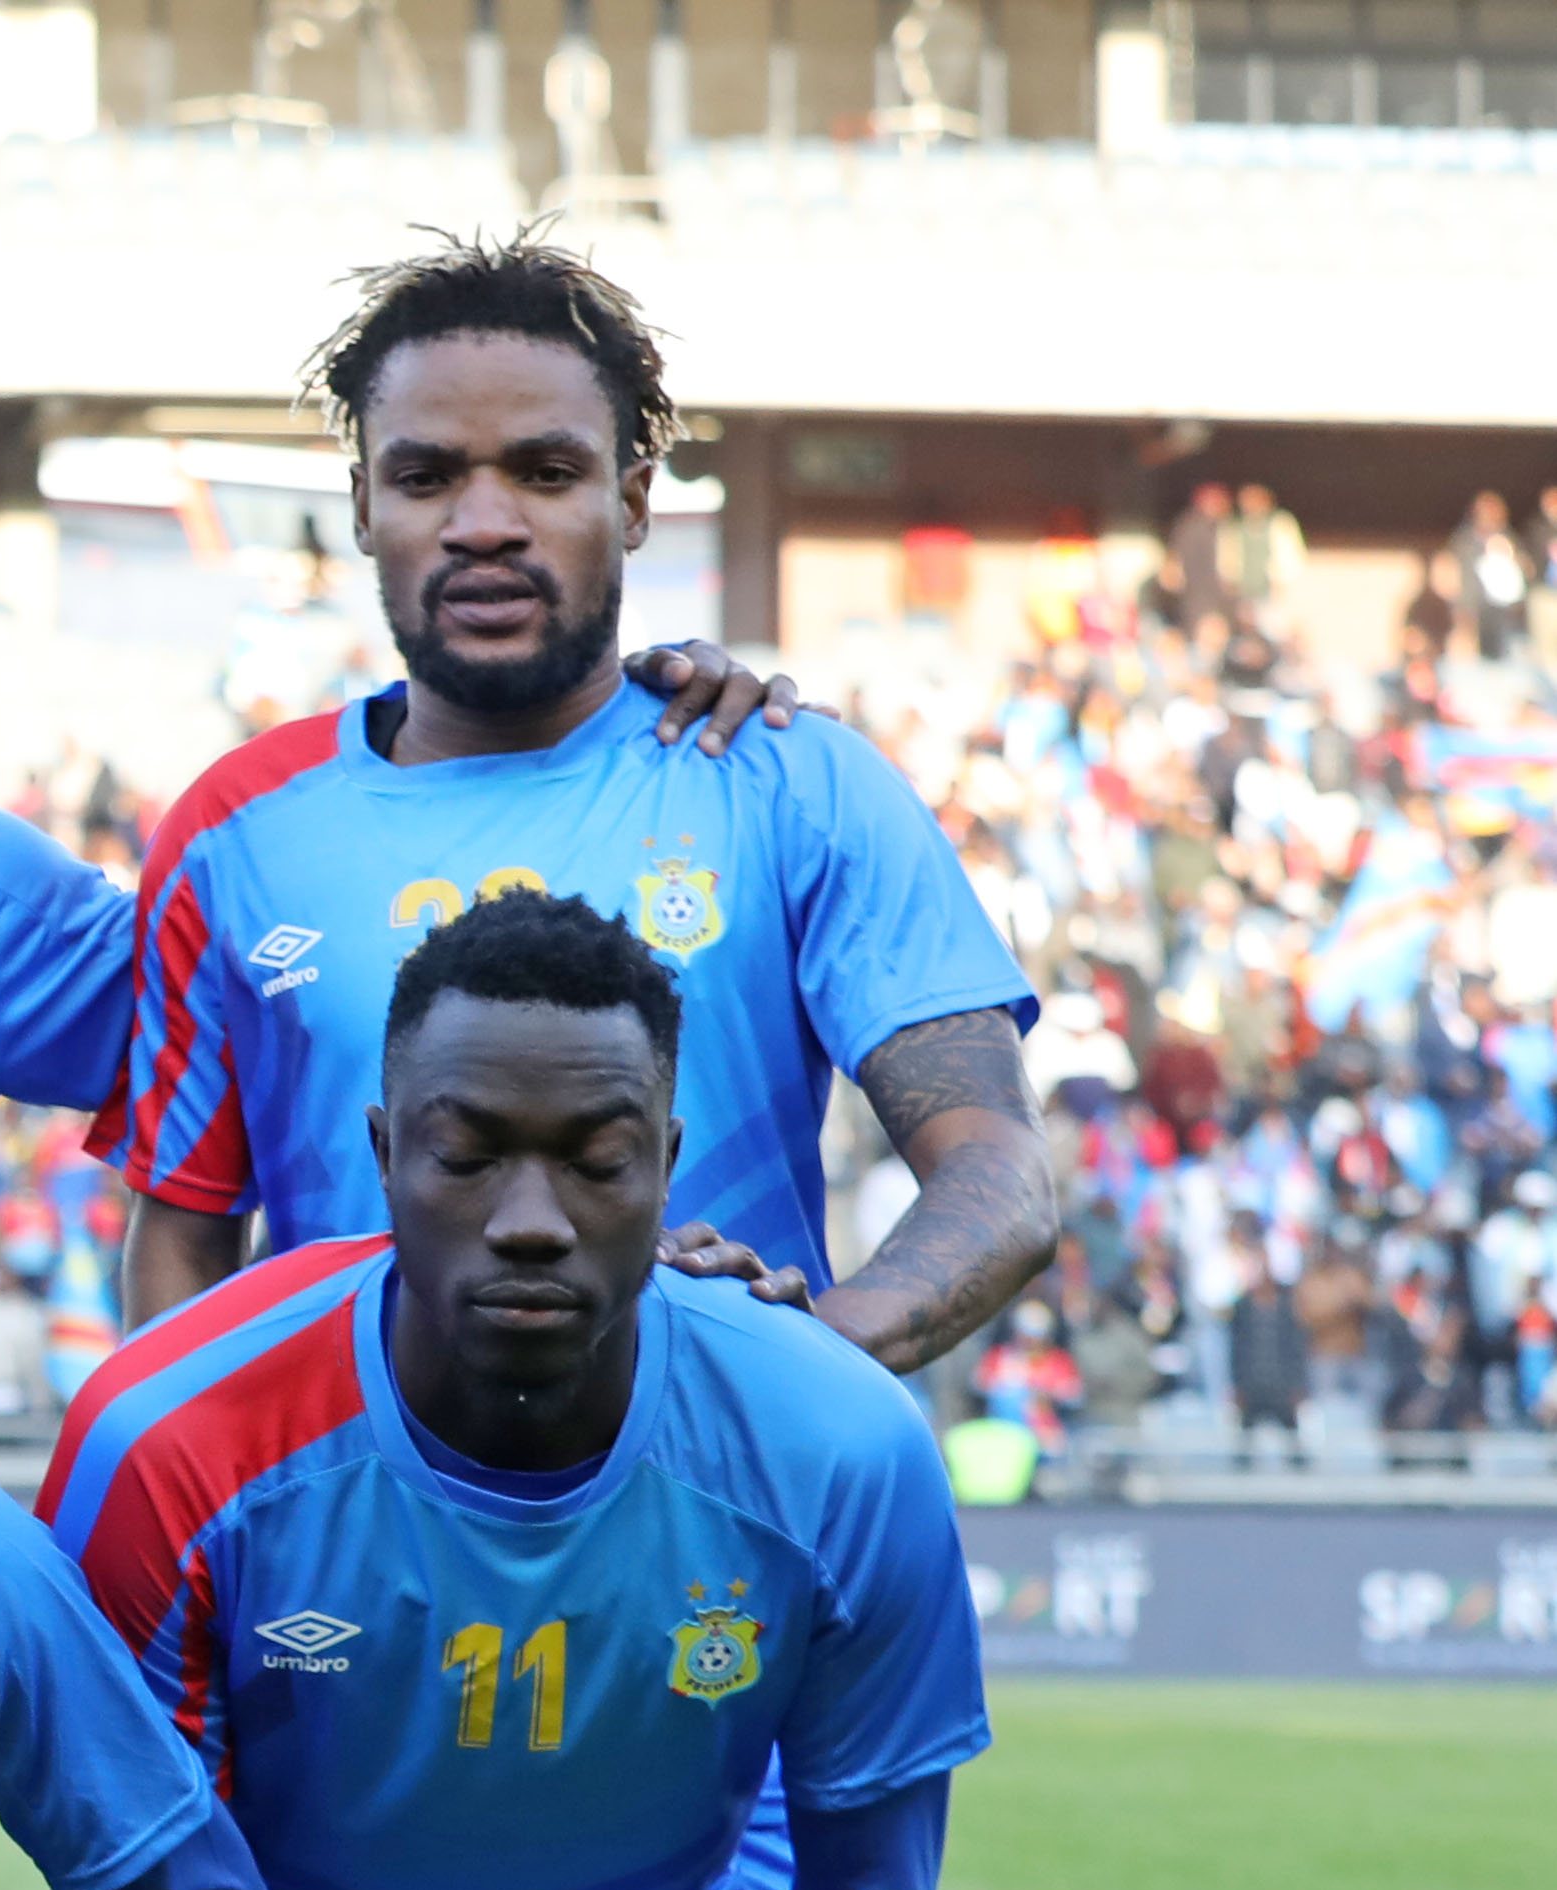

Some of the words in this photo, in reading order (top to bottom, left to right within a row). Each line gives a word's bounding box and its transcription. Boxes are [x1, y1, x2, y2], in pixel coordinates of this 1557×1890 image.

[654, 925, 710, 948] FECOFA
[262, 965, 320, 997] umbro
[263, 1655, 350, 1673] umbro
[442, 1620, 567, 1751] 11
